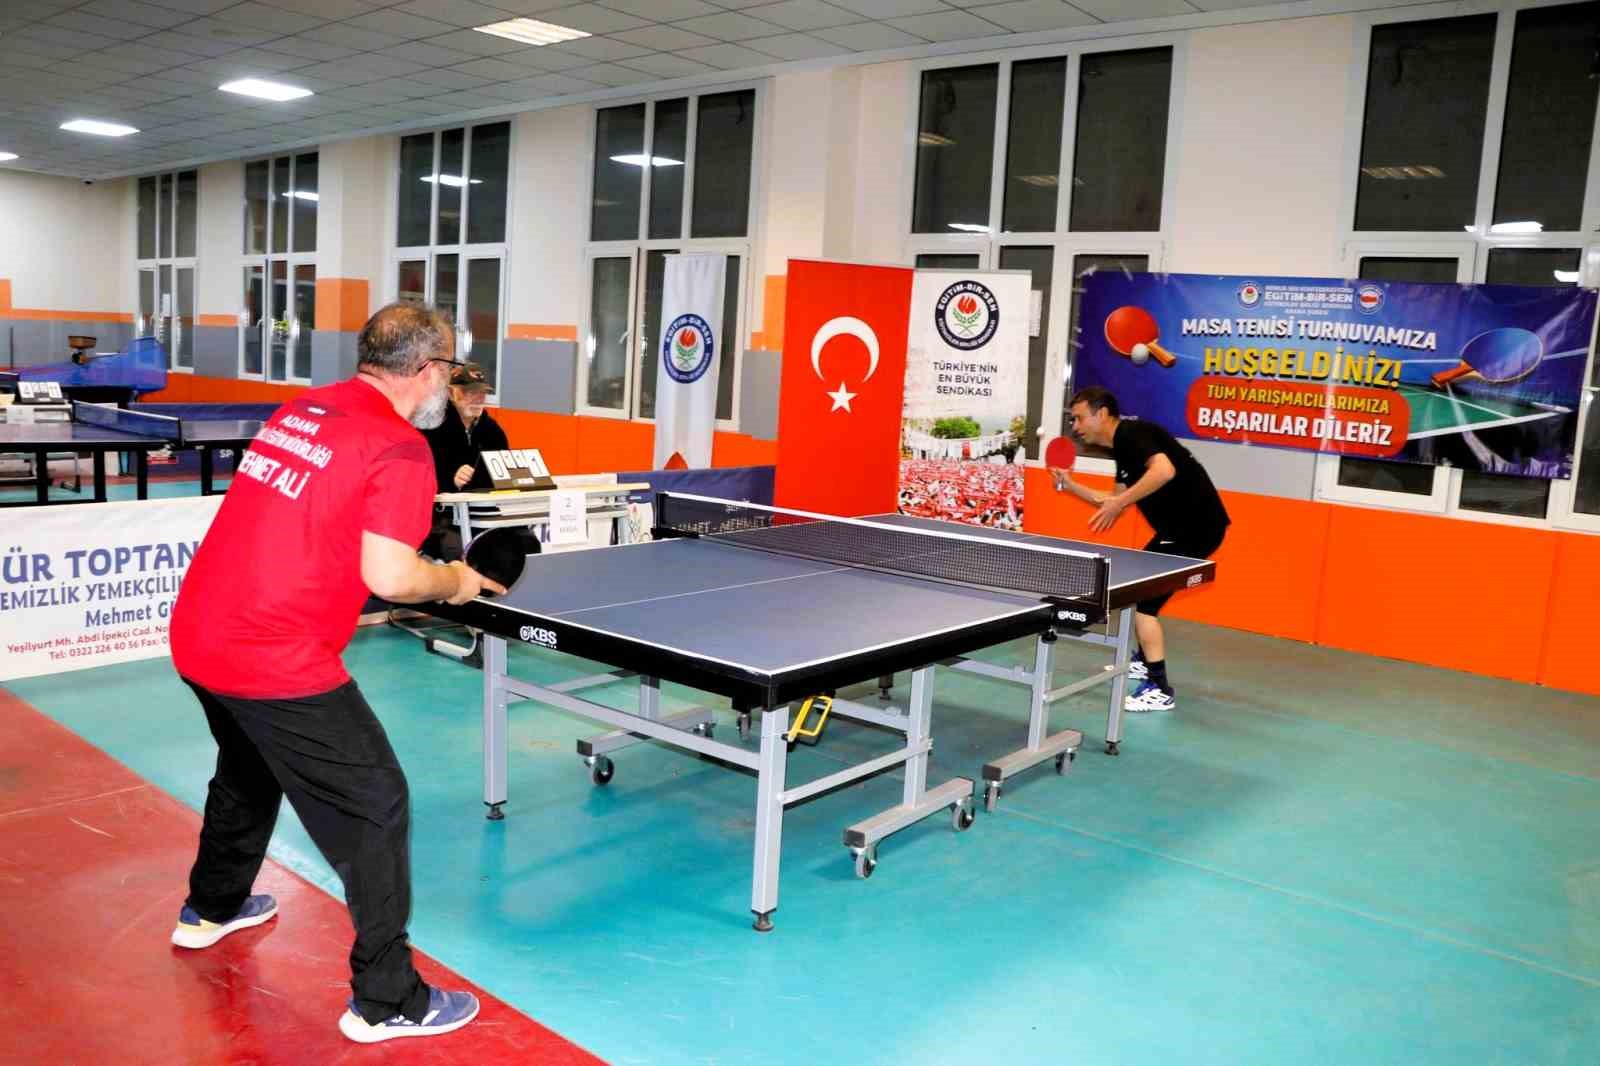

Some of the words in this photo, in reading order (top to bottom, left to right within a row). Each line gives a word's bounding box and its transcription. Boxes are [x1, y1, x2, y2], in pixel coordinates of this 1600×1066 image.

[1182, 318, 1232, 337] MASA
[1236, 315, 1294, 339] TENİSİ
[1299, 320, 1437, 351] TURNUVAMIZA
[938, 373, 952, 383] EN
[955, 373, 991, 385] BÜYÜK
[1203, 346, 1402, 389] HOŞGELDİNİZ!
[936, 385, 993, 397] SENDİKASI
[1207, 383, 1236, 401] TÜM
[1239, 388, 1390, 415] YARIŞMACILARIMIZA
[279, 414, 321, 436] ADANA
[1197, 407, 1308, 437] BAŞARILAR
[1312, 416, 1393, 446] DİLERİZ
[237, 449, 282, 484] EHMET
[271, 467, 311, 500] ALİ
[0, 582, 80, 611] EMİZLİK
[85, 603, 152, 628] Mehmet
[7, 640, 52, 654] Yeşilyurt
[55, 637, 74, 648] Mh.
[77, 631, 101, 644] Abdi
[102, 627, 130, 642] İpekçi
[530, 625, 557, 645] KBS
[69, 646, 92, 658] 0322
